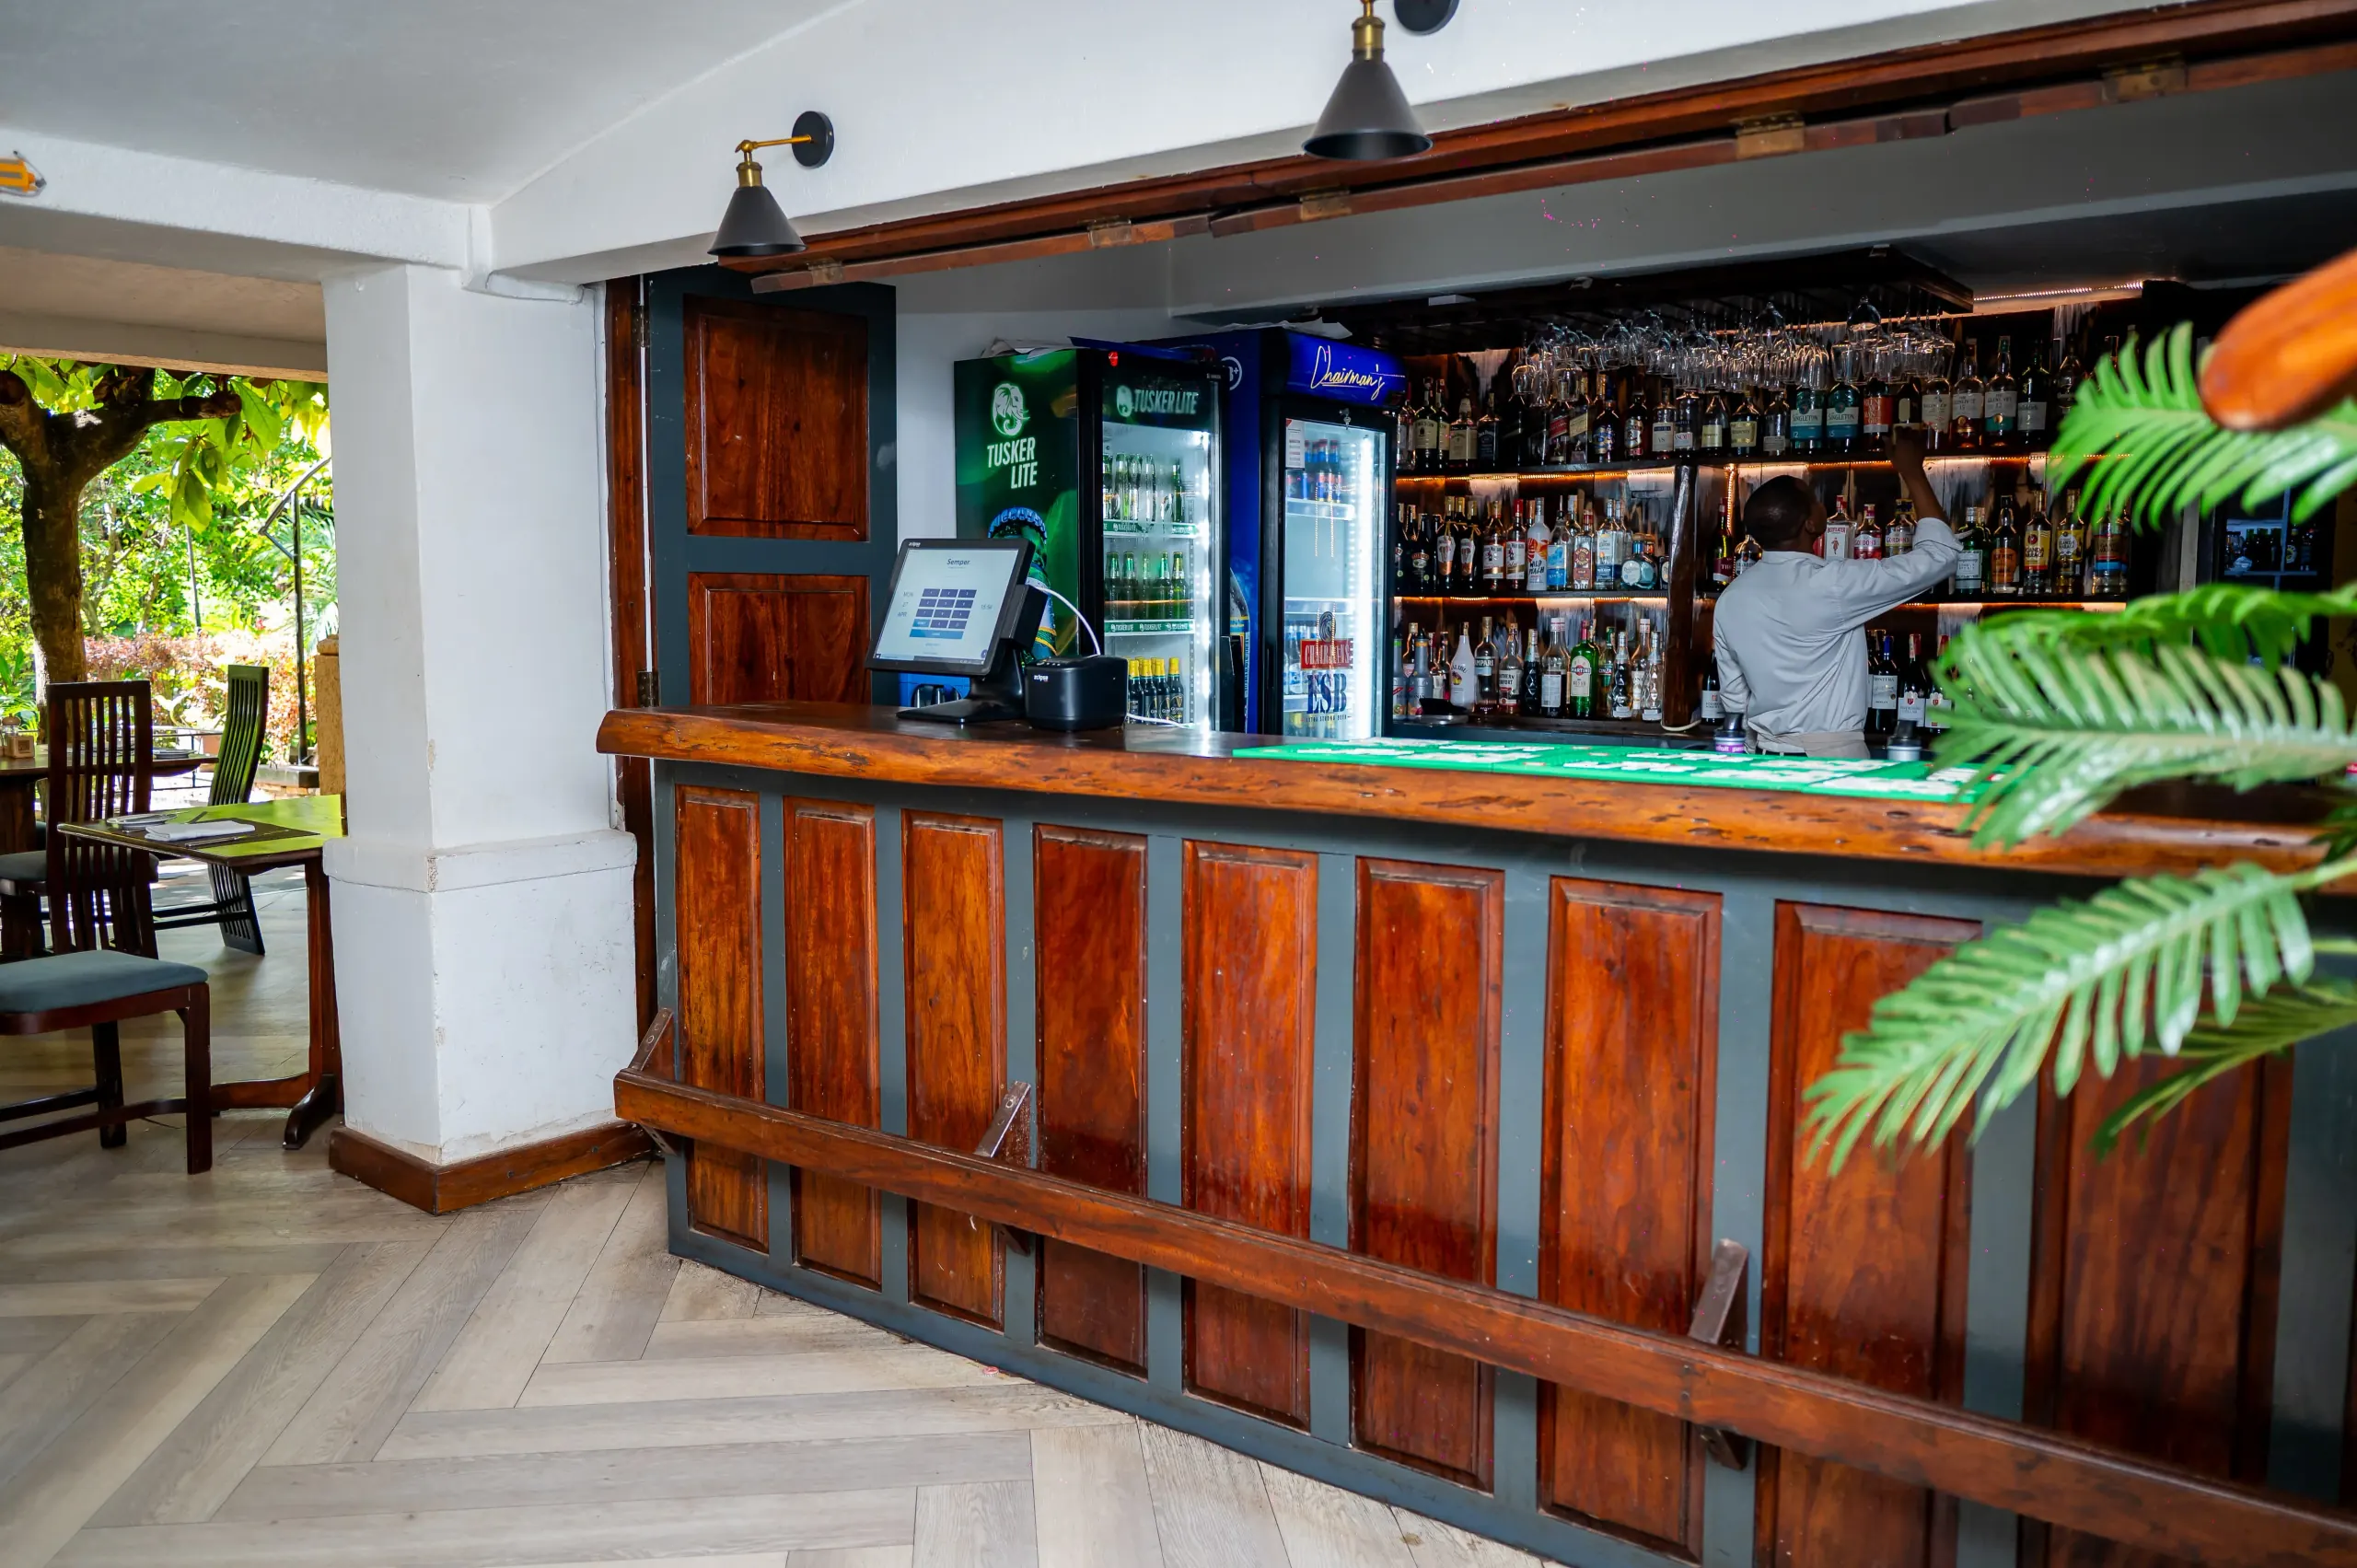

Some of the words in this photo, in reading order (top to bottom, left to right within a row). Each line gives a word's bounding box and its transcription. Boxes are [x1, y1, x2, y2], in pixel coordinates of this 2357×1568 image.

[1311, 345, 1385, 401] Chairman's
[1133, 389, 1176, 414] TUSKER
[1175, 390, 1200, 414] LITE
[1792, 413, 1818, 422] SINGLETON
[1828, 412, 1854, 421] SINGLETON
[987, 436, 1036, 469] TUSKER
[1011, 461, 1038, 490] LITE
[1529, 560, 1542, 568] WILD
[1306, 673, 1347, 714] ESB
